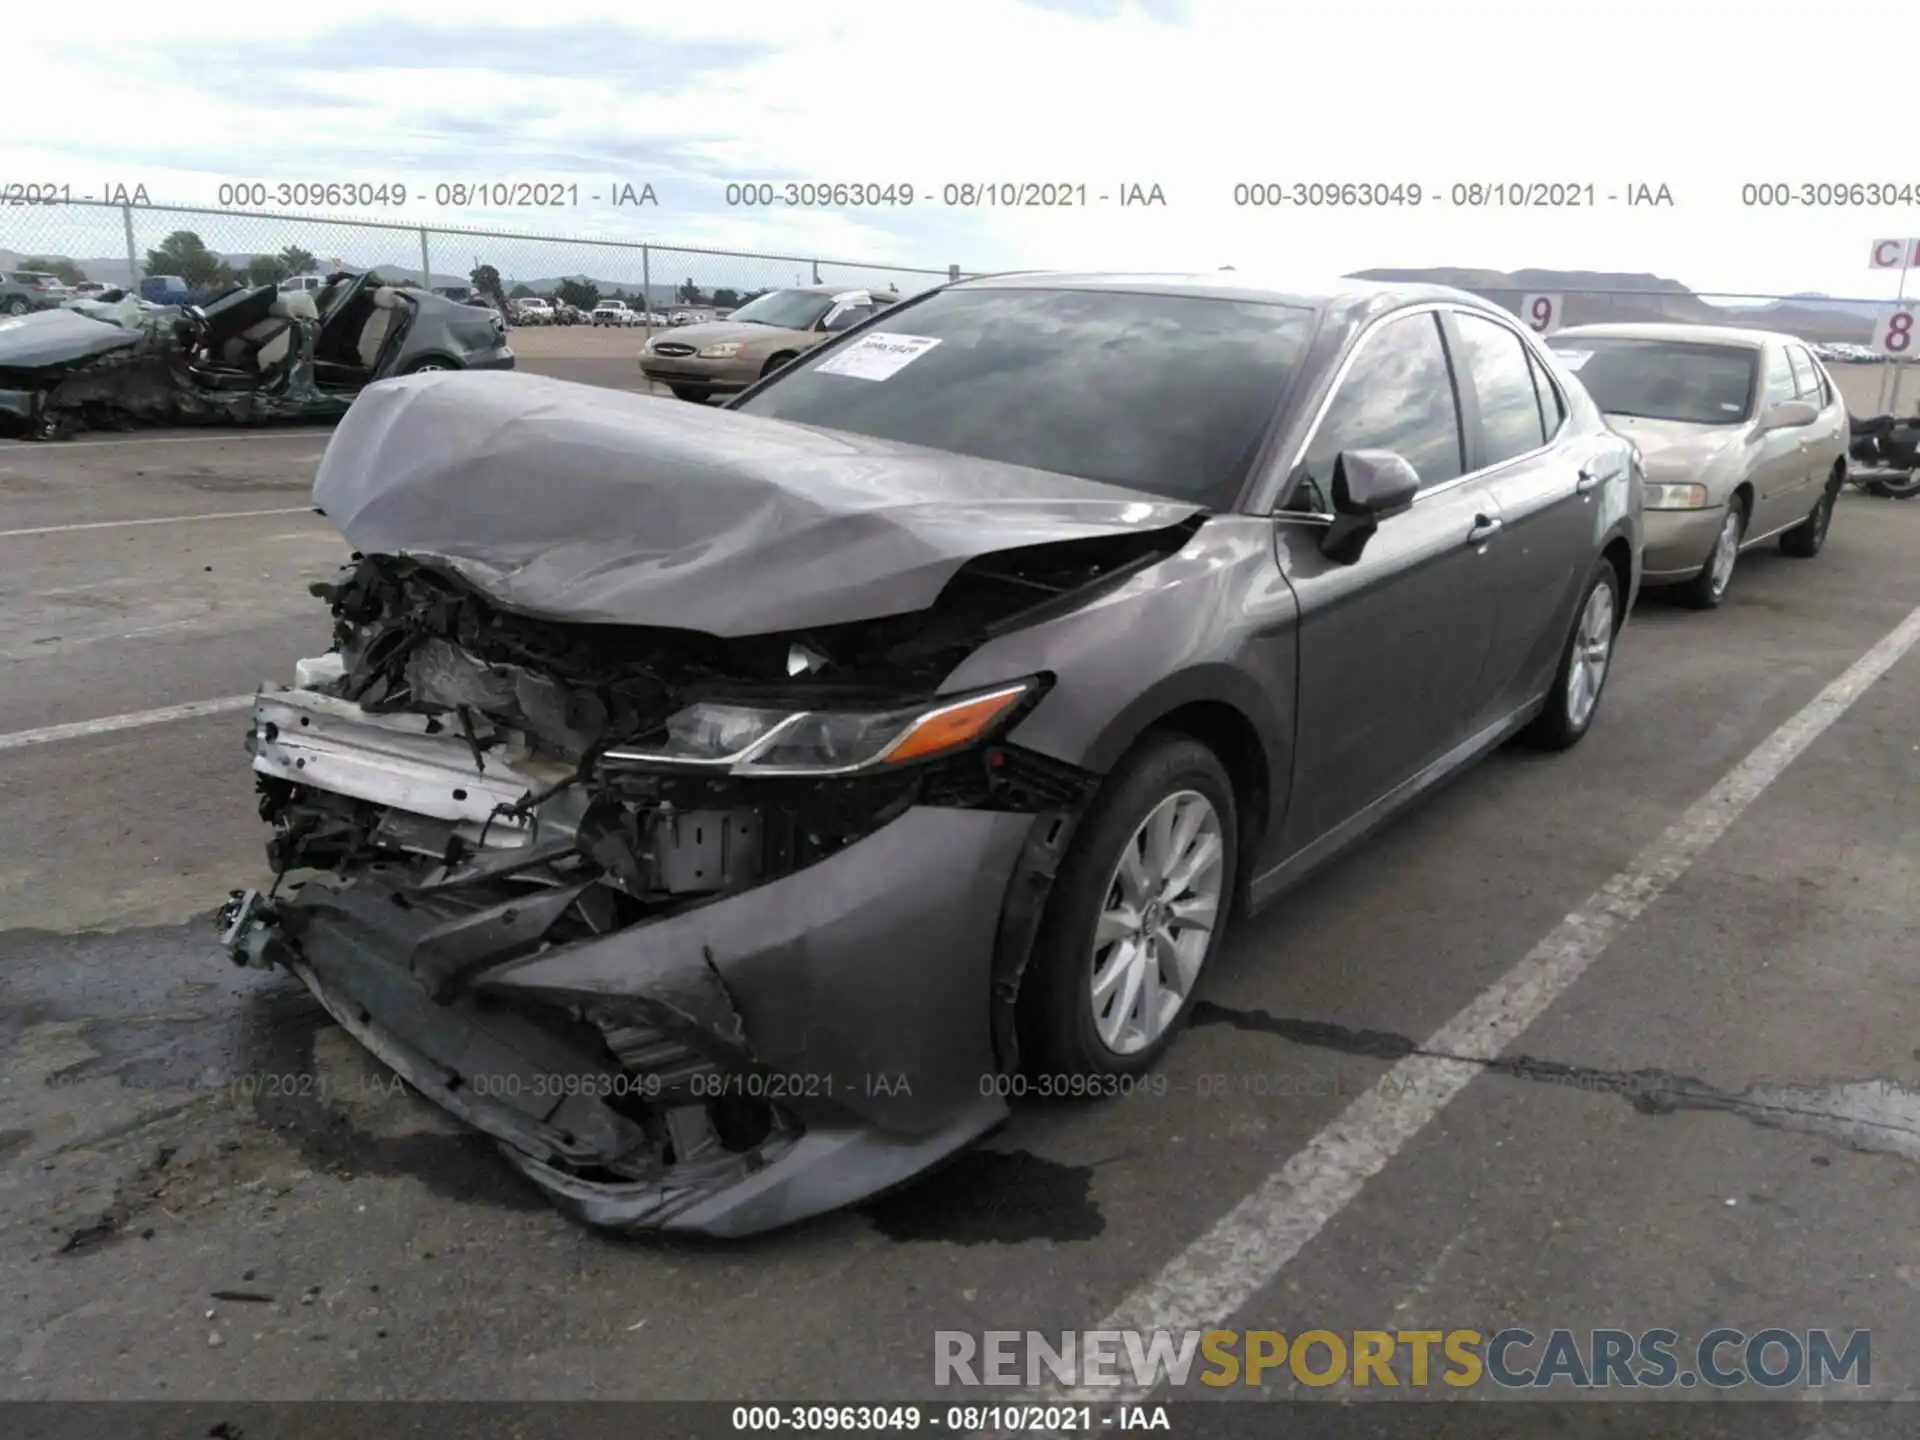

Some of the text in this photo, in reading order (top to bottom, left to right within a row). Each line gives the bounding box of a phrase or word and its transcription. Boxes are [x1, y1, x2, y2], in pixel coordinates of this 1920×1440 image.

[1874, 240, 1901, 267] C
[1530, 297, 1552, 333] 9
[1884, 311, 1914, 353] 8
